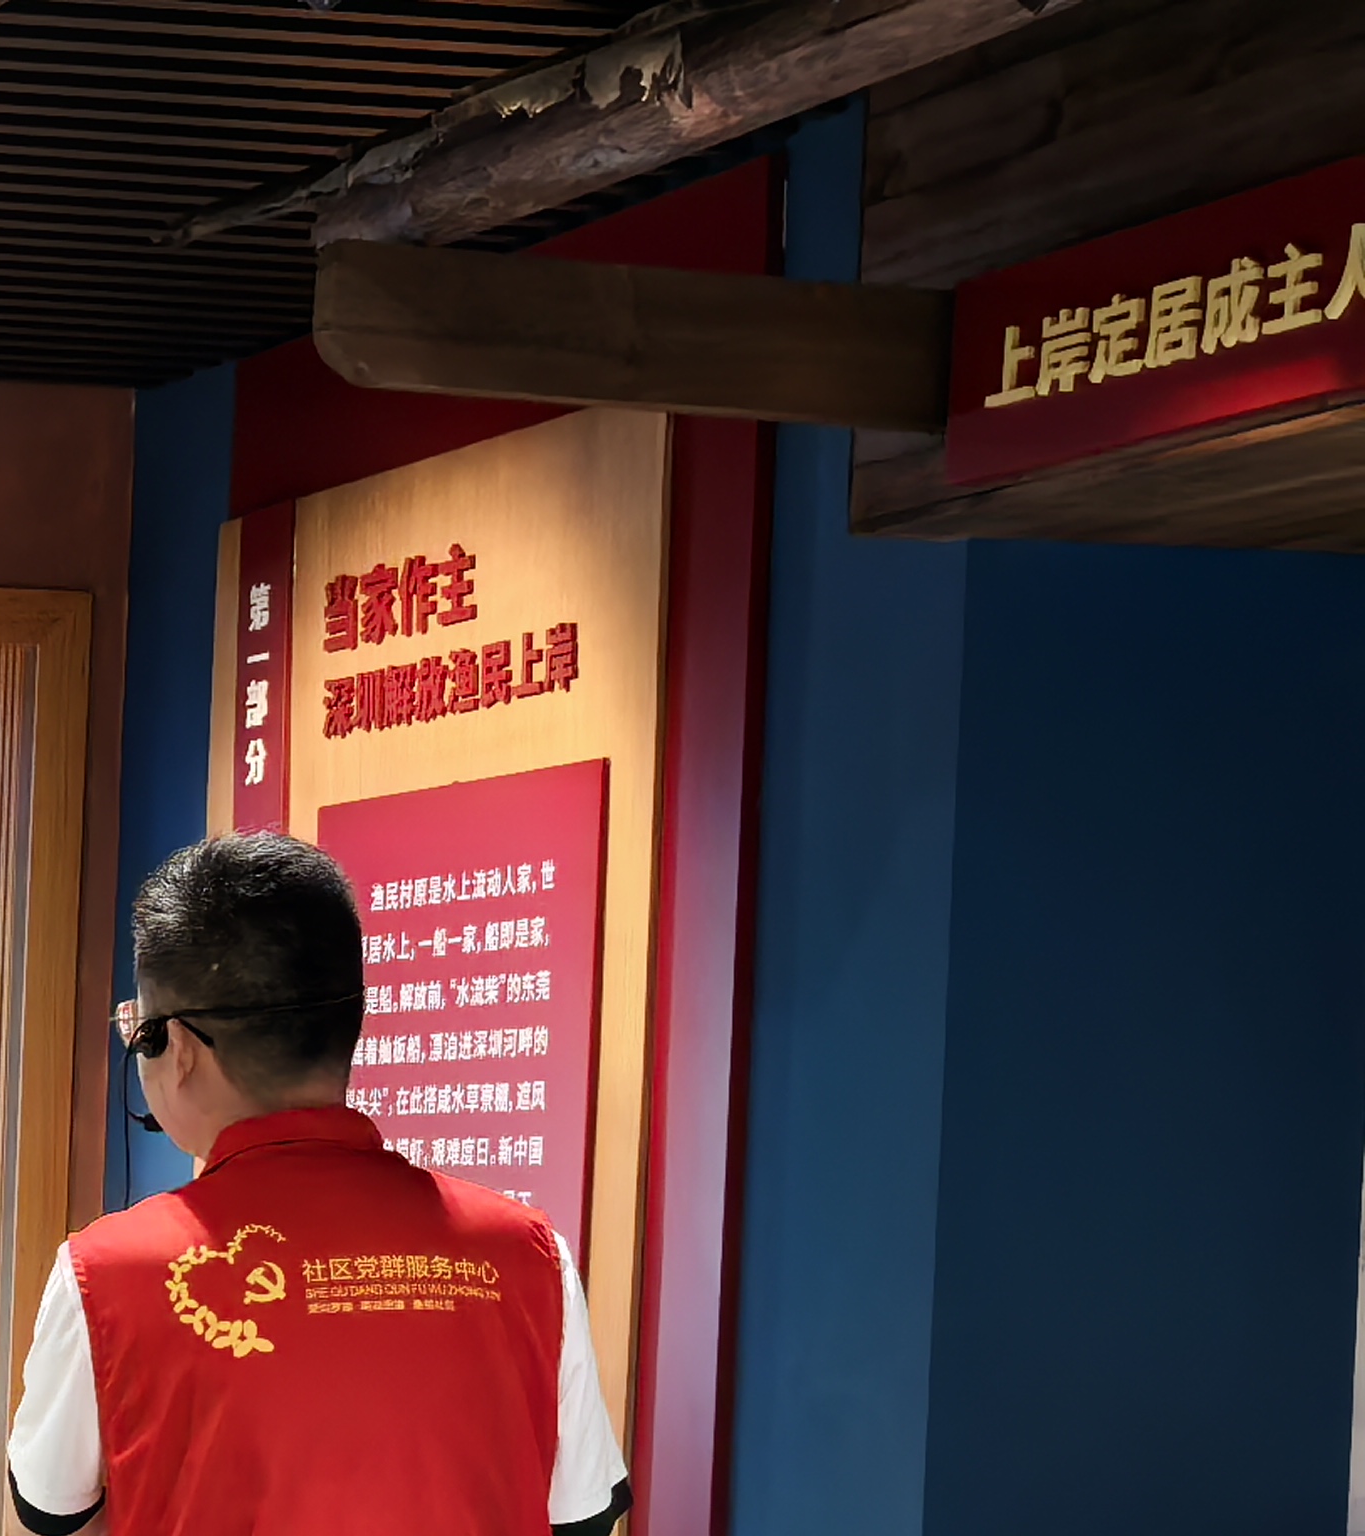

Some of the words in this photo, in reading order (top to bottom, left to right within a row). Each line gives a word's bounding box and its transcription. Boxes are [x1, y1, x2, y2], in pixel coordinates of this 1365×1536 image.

[323, 544, 478, 653] 当家作主
[245, 582, 271, 786] 第一部分
[322, 623, 579, 739] 深圳解放渔民上岸
[302, 1255, 500, 1284] 社区党群服务中心
